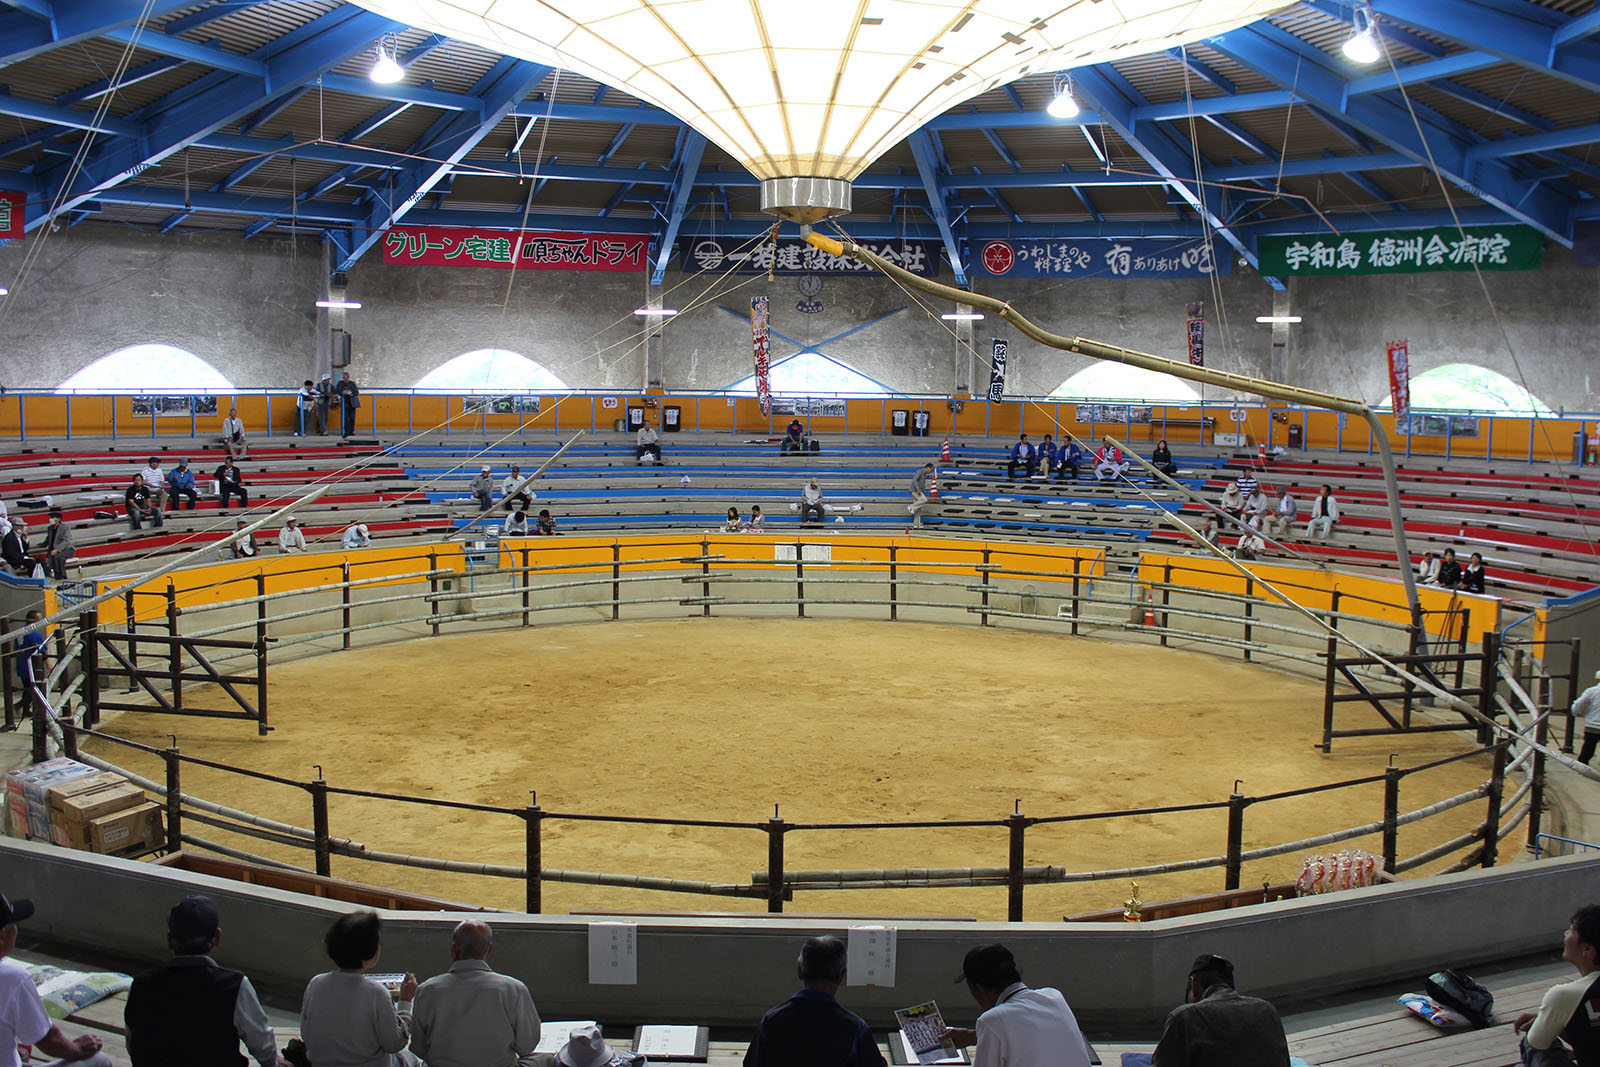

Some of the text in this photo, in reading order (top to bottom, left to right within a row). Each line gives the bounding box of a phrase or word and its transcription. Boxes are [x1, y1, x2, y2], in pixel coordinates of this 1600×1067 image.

[386, 232, 646, 265] グリーン宅建 順ちゃんドライ
[1285, 233, 1511, 270] 宇和島 徳洲会病院
